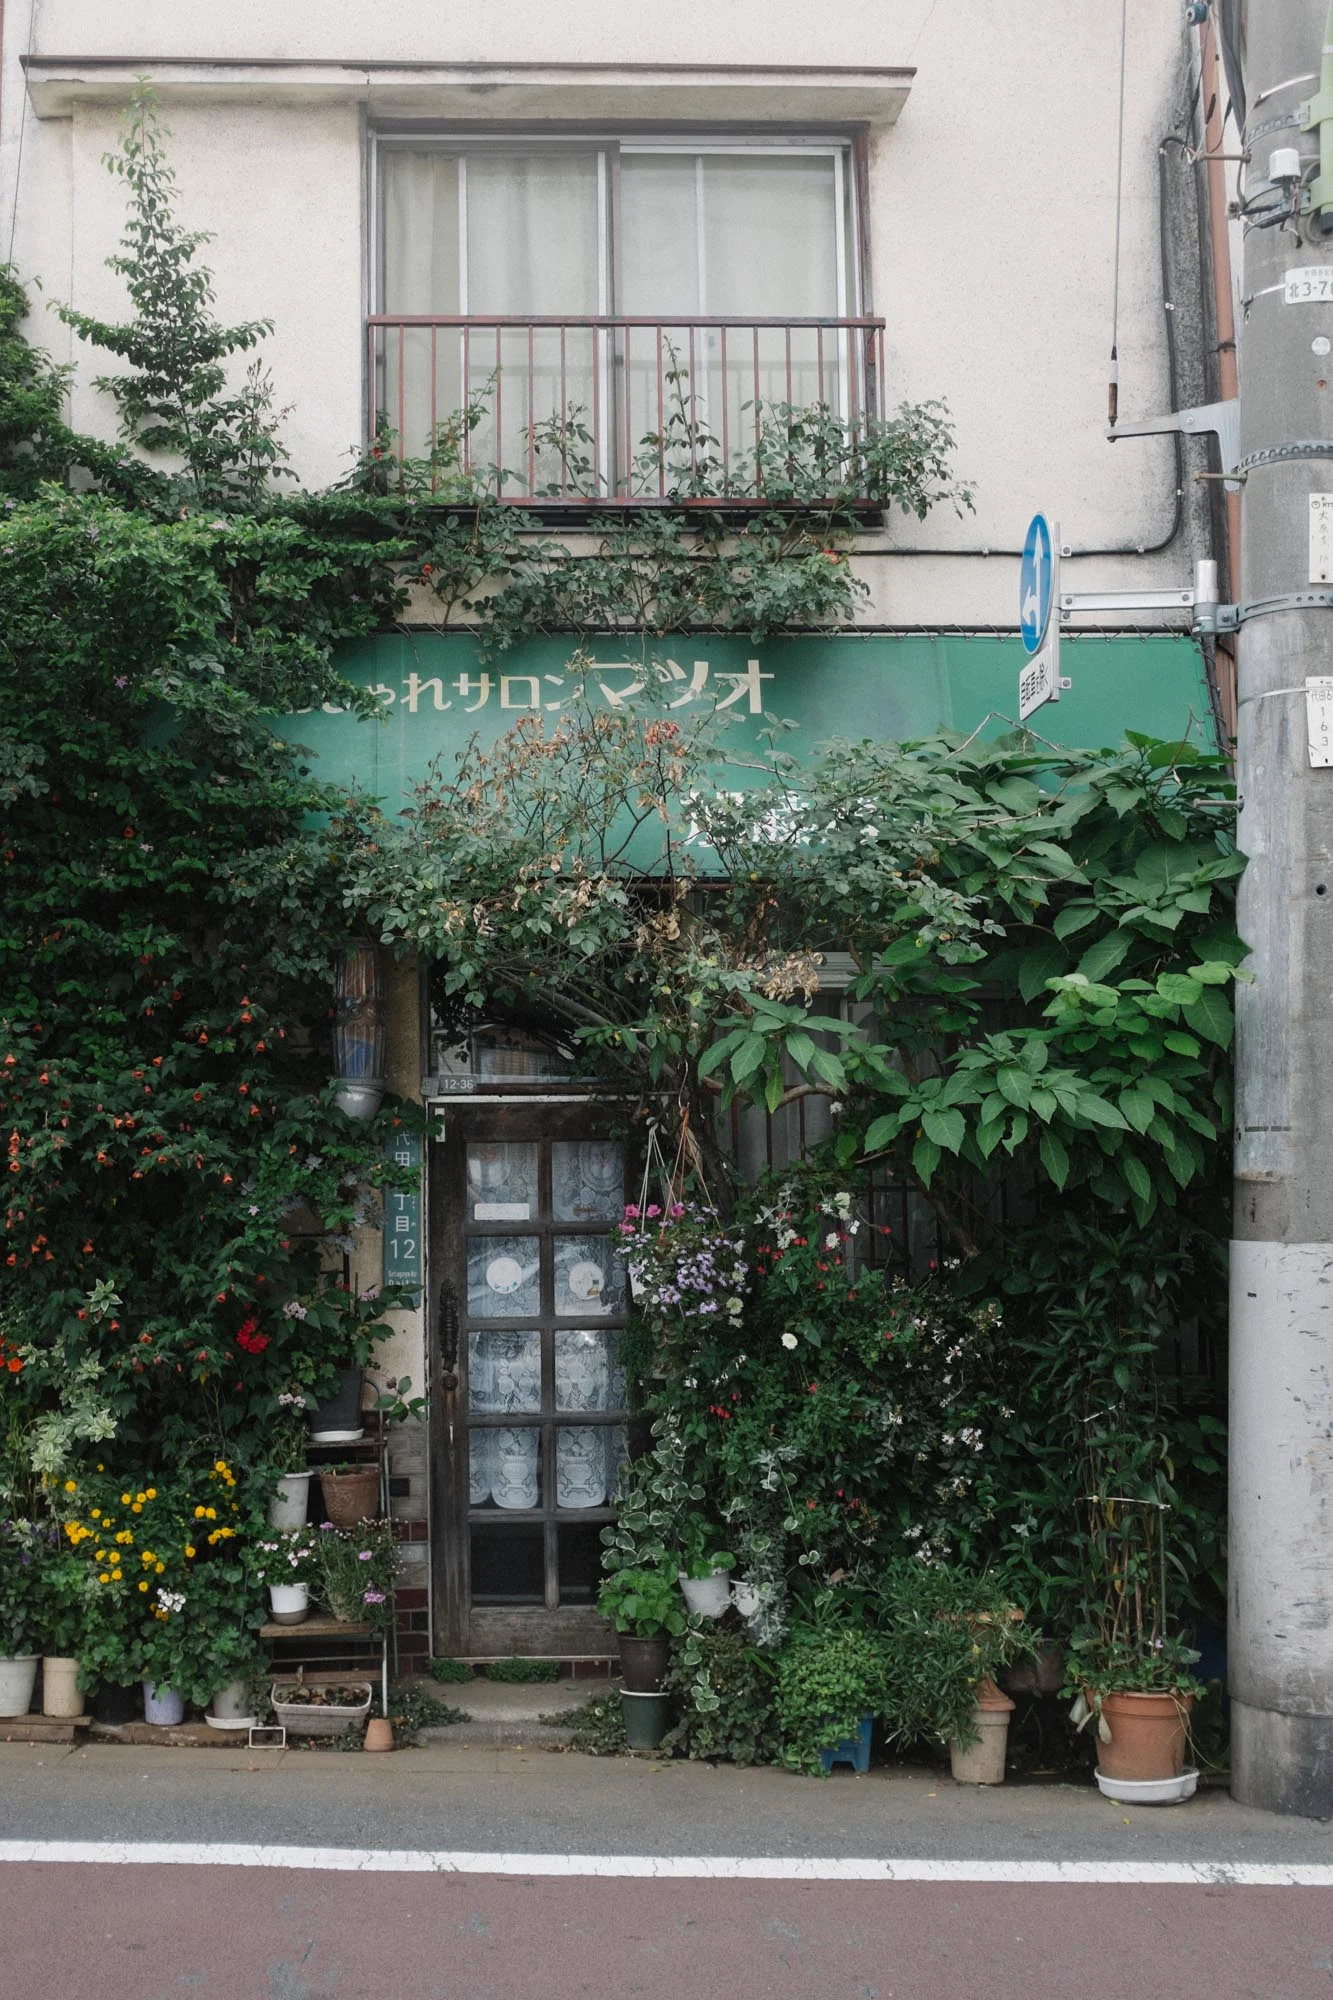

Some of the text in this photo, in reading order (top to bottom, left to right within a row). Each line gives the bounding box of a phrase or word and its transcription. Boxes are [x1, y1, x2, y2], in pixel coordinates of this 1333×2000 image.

[444, 1079, 474, 1090] 12-36
[394, 1131, 411, 1232] 代田丁目
[390, 1239, 416, 1259] 12
